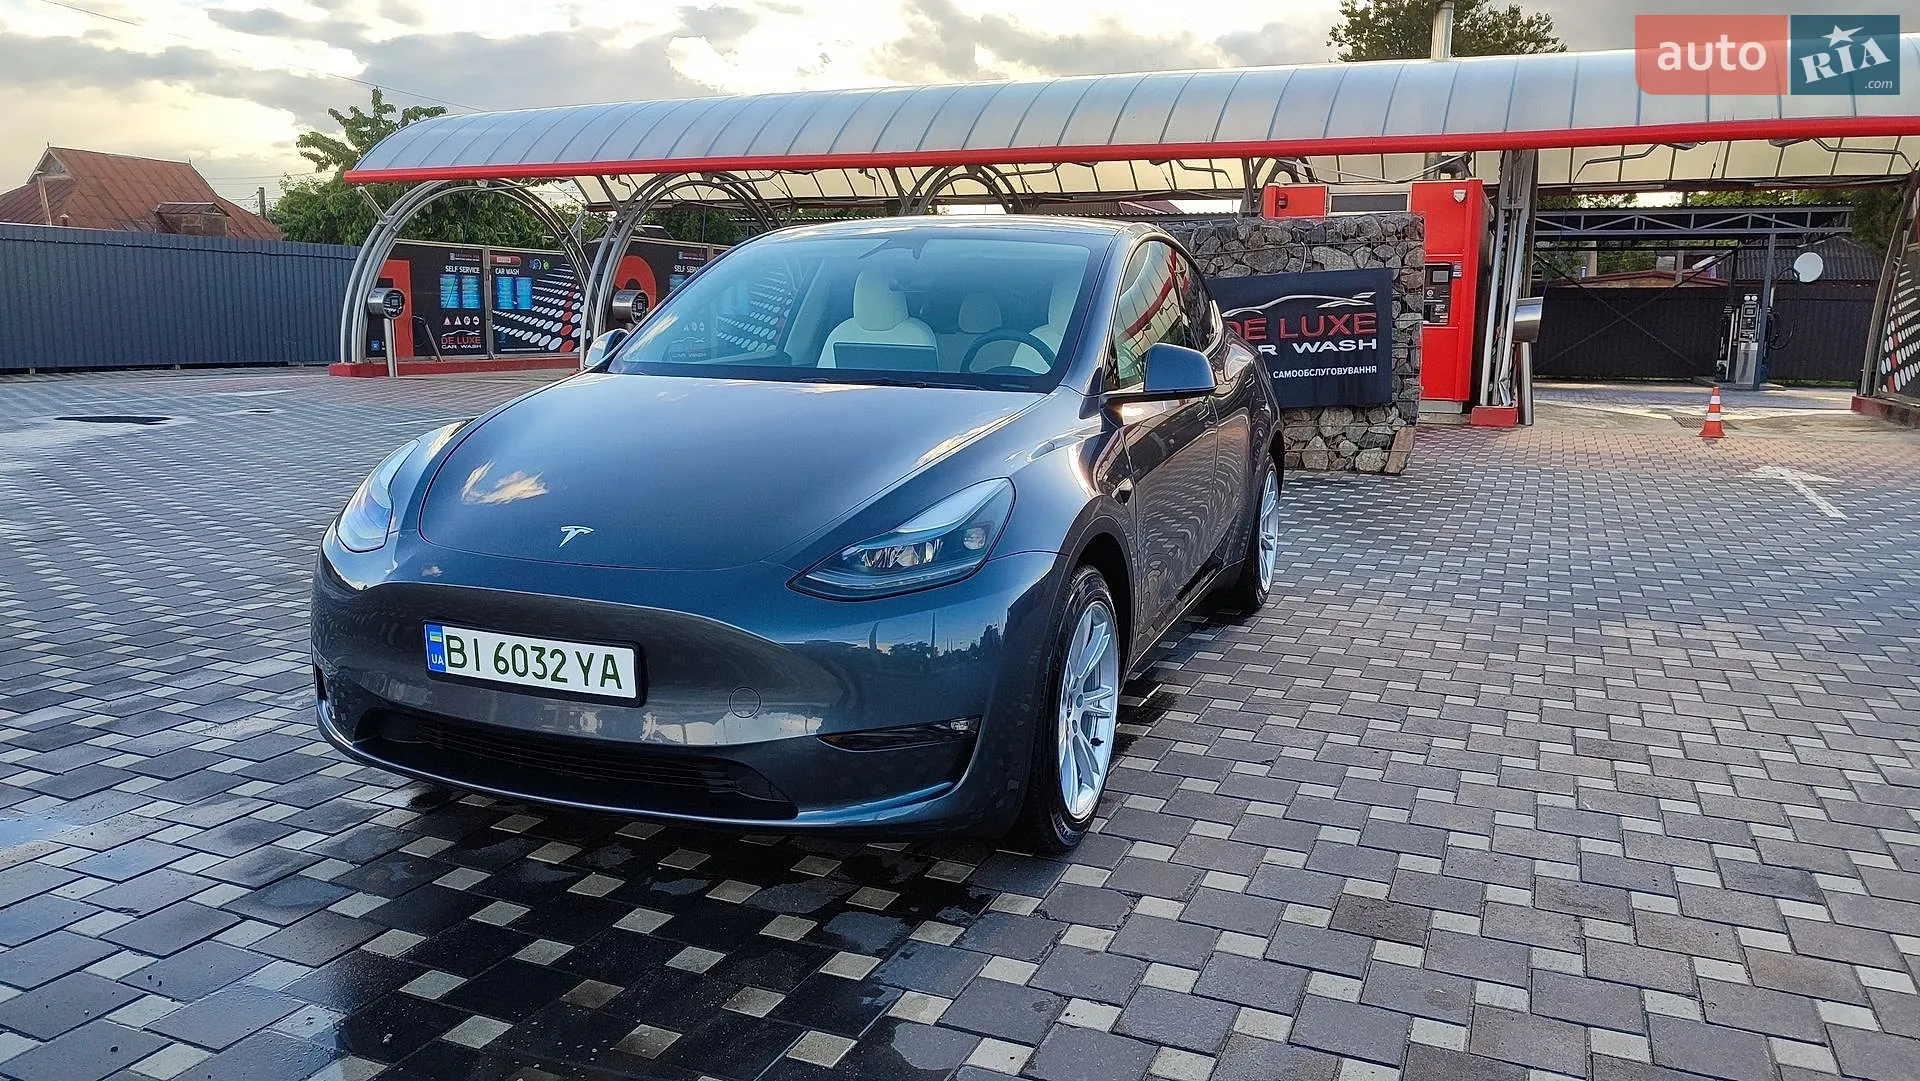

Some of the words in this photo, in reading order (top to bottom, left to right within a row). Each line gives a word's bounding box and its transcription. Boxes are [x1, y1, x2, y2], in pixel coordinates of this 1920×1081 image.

[445, 265, 459, 273] SELF
[459, 266, 480, 274] SERVICE
[495, 268, 509, 276] CAR
[509, 268, 520, 276] WASH
[674, 264, 686, 273] SELF
[1279, 311, 1377, 339] LUXE
[441, 336, 455, 344] DE
[457, 336, 481, 344] LUXE
[1292, 338, 1377, 354] WASH
[1273, 365, 1377, 379] САМООБСЛУГОВУВАННЯ
[431, 653, 445, 666] UA
[493, 641, 568, 684] 6032
